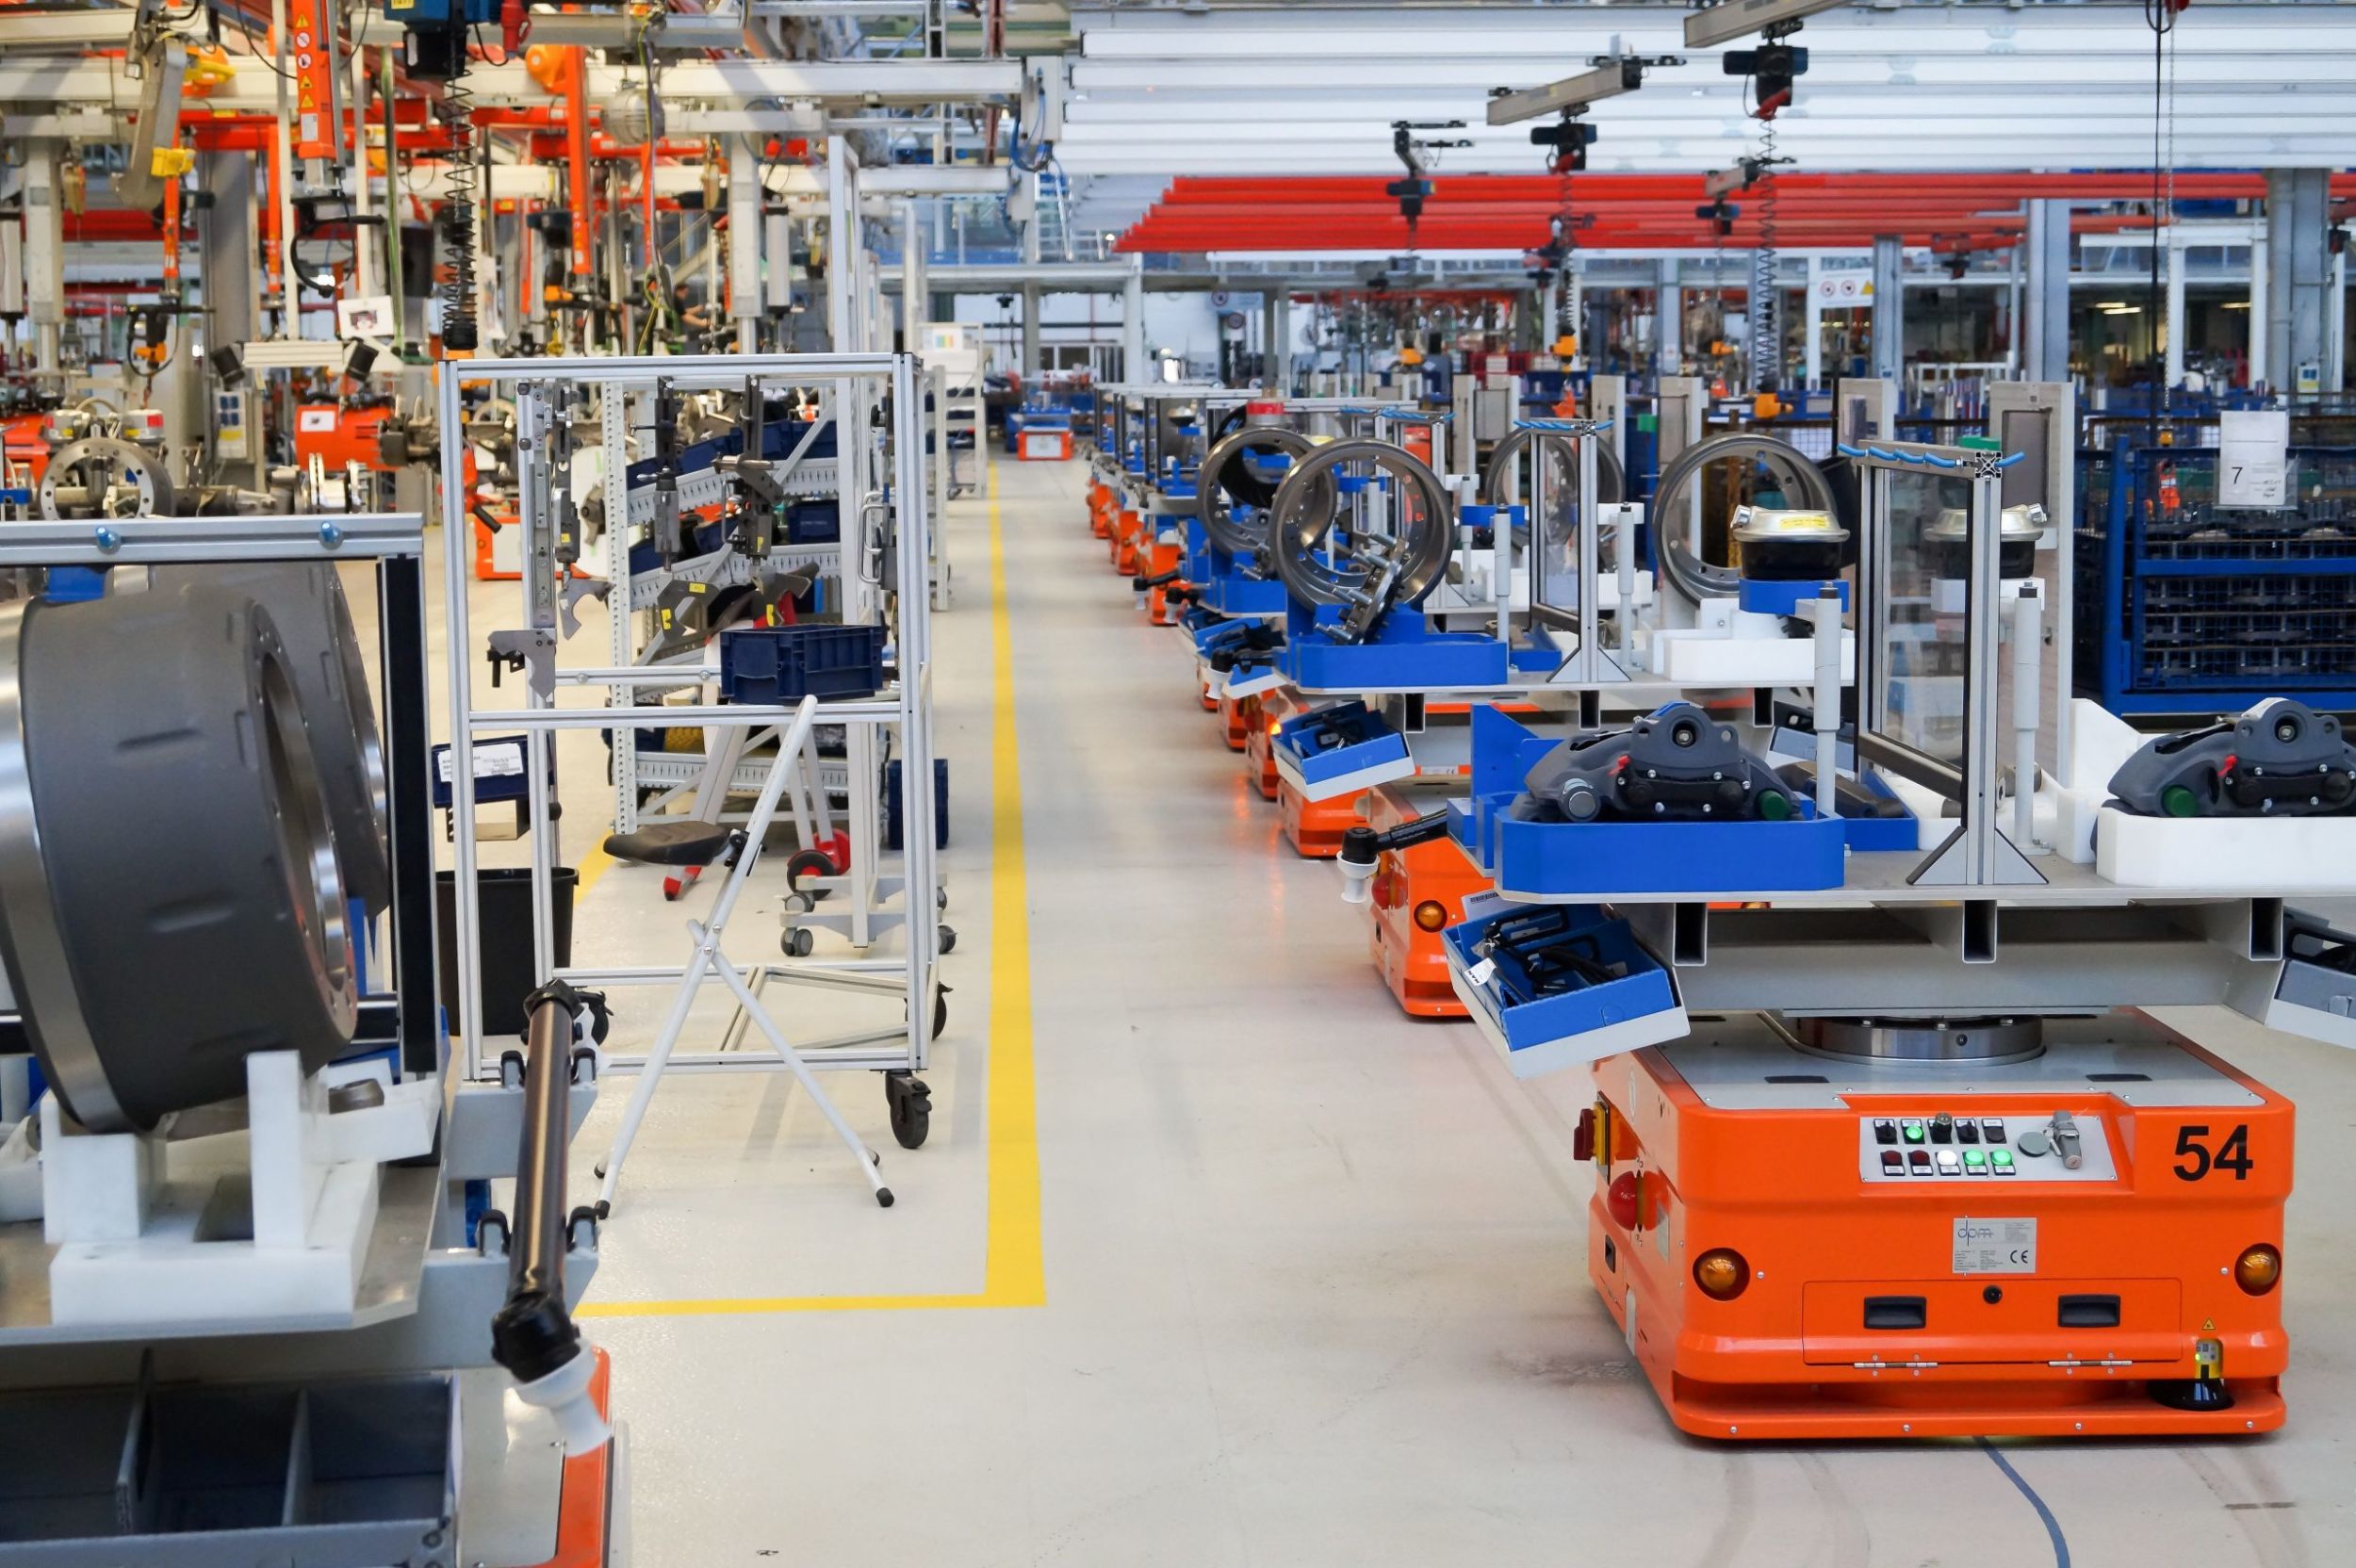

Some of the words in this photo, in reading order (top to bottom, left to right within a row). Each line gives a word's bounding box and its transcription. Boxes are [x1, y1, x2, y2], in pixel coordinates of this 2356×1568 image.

[2232, 466, 2243, 485] 7
[2173, 1124, 2253, 1181] 54
[1957, 1219, 1992, 1247] dpm
[2009, 1250, 2029, 1264] CE
